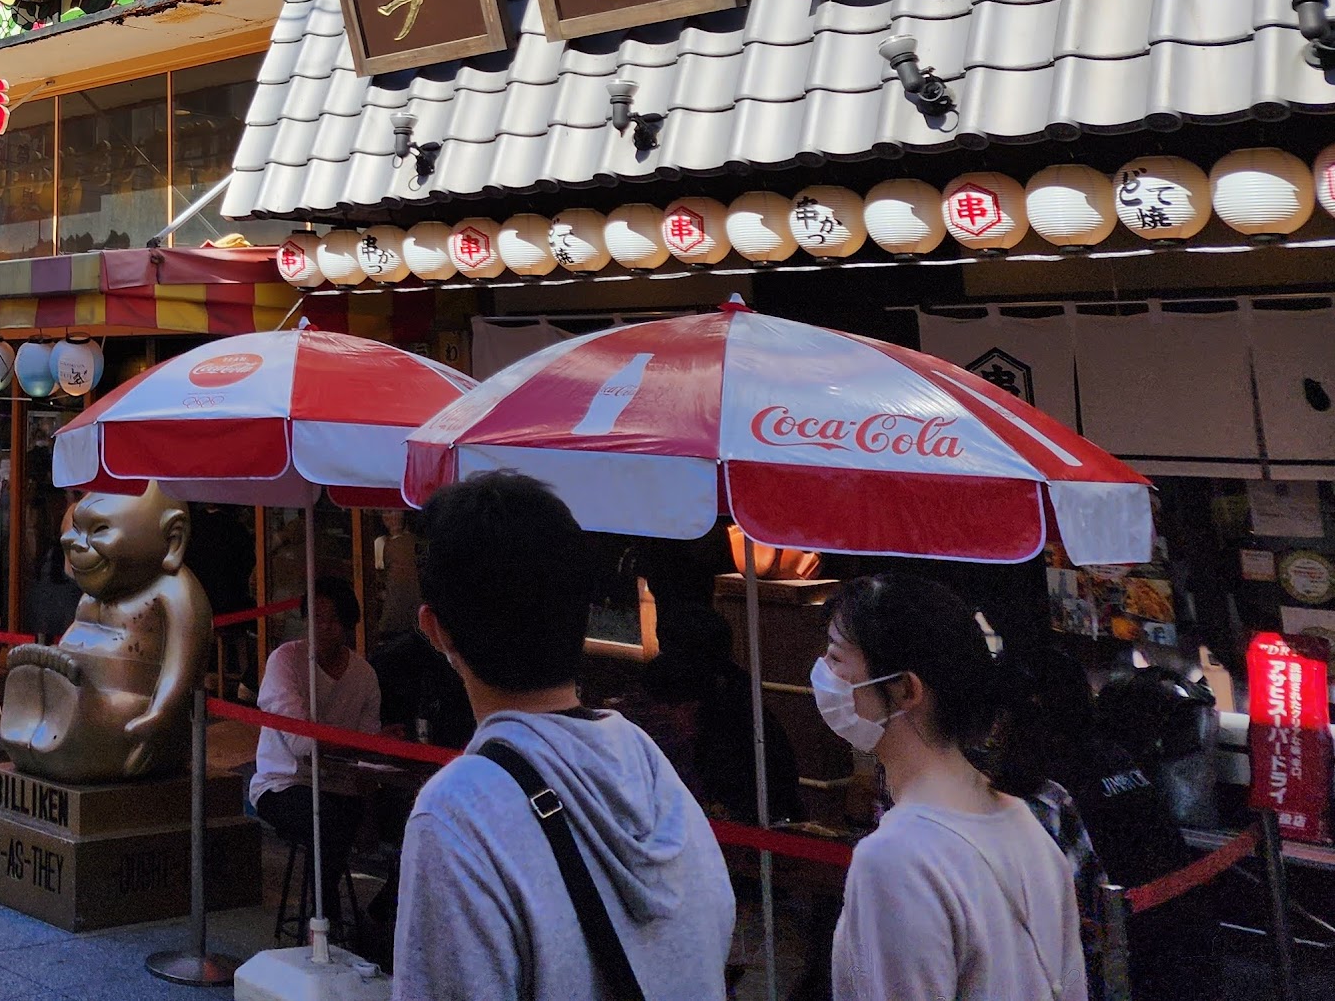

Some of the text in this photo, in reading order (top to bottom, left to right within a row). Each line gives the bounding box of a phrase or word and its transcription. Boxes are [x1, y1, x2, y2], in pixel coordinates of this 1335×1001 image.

[793, 195, 843, 246] 串かつ
[957, 193, 988, 227] 串
[1119, 167, 1179, 229] どて焼
[460, 234, 481, 261] 串
[671, 215, 693, 244] 串
[361, 234, 395, 274] 串かつ
[750, 406, 964, 459] Coca-Cola
[1267, 659, 1289, 805] アサヒスーパードライ
